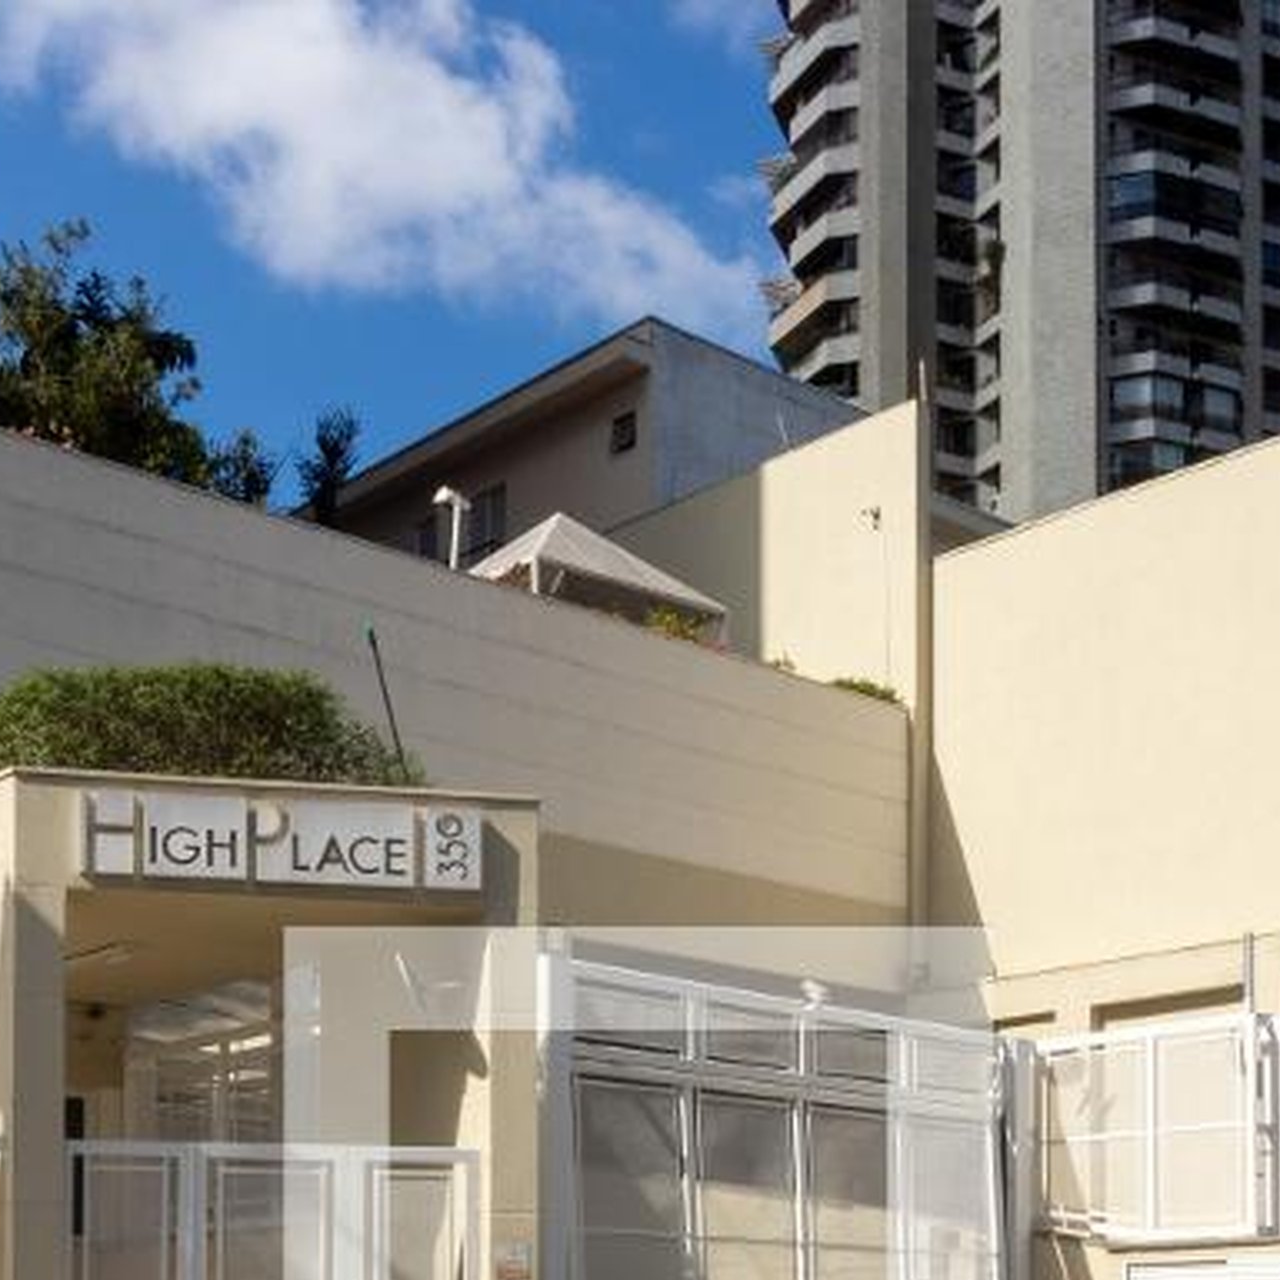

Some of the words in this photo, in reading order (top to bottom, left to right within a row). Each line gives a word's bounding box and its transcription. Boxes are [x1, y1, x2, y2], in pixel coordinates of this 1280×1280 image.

[86, 793, 239, 878] HIGH
[244, 800, 408, 878] PLACE
[434, 811, 470, 881] 350
